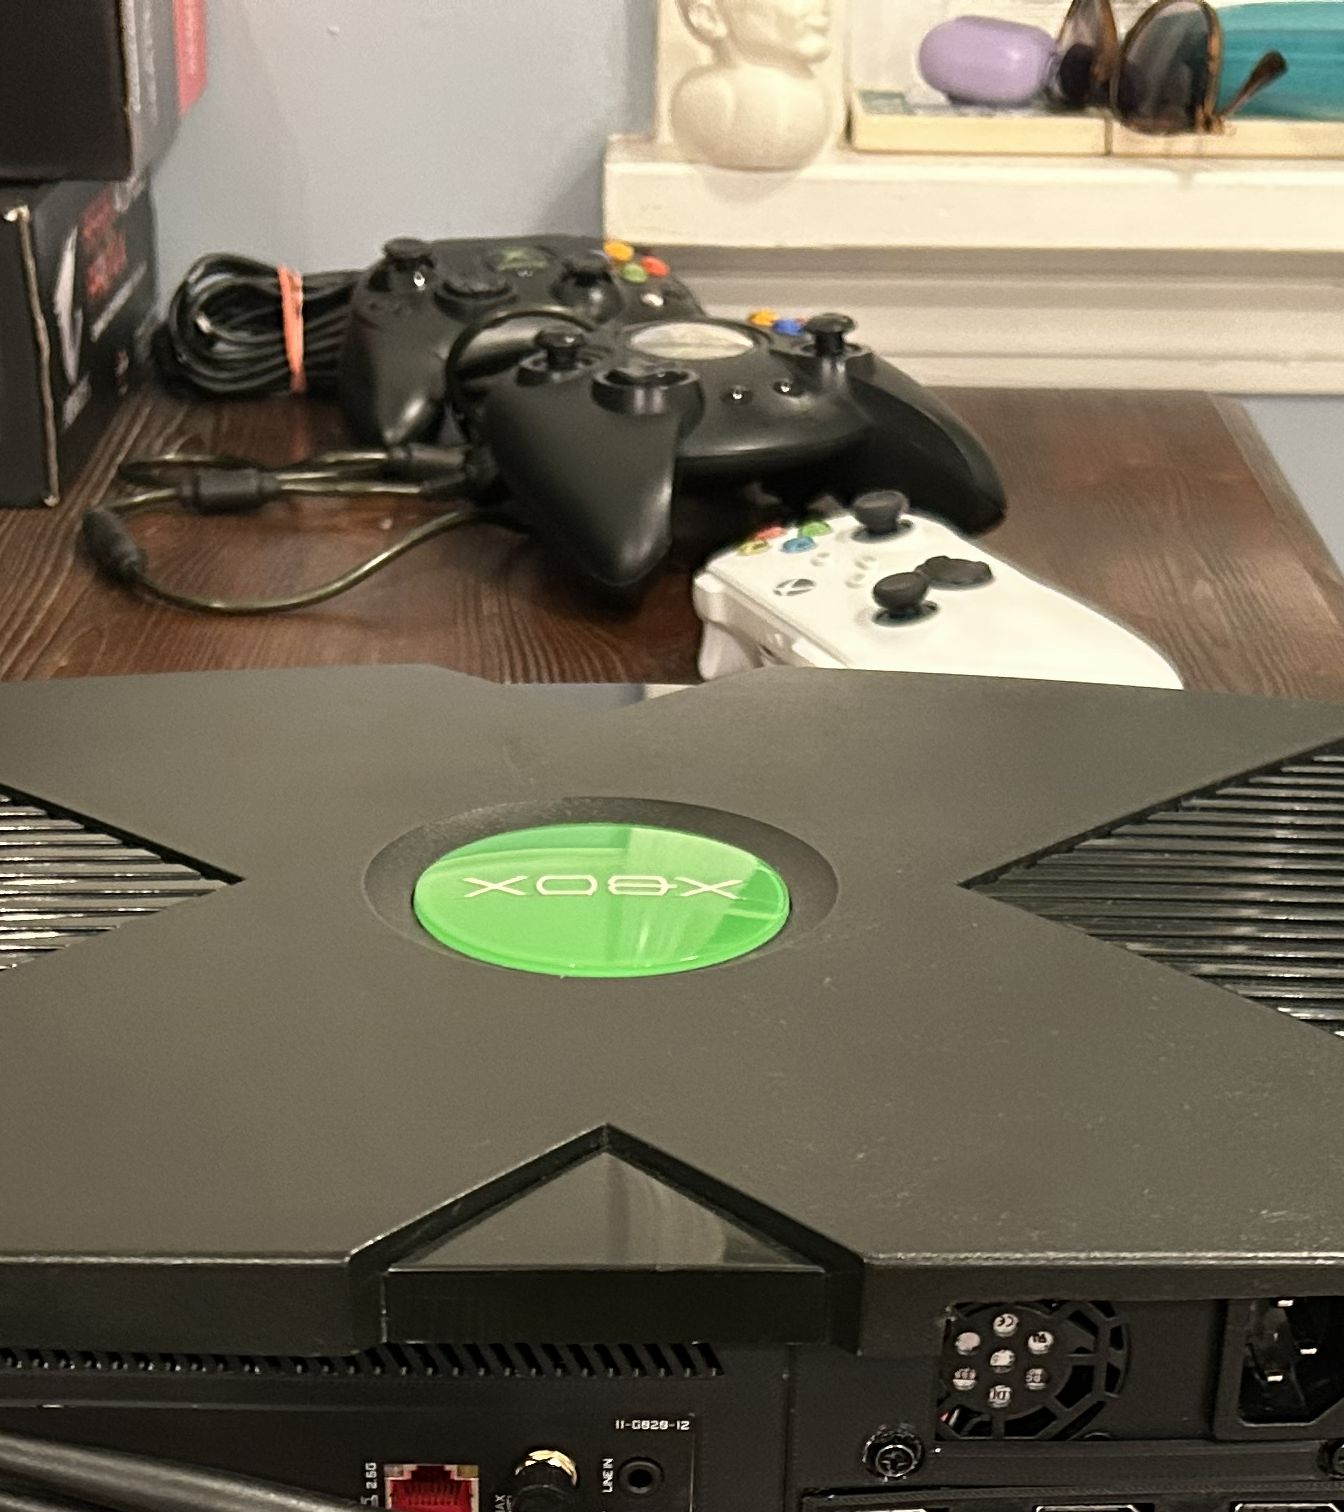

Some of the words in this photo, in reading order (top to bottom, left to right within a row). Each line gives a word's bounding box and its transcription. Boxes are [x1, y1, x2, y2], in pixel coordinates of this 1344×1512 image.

[462, 874, 746, 901] XBOX
[602, 1457, 614, 1470] IN
[601, 1470, 614, 1493] LINE
